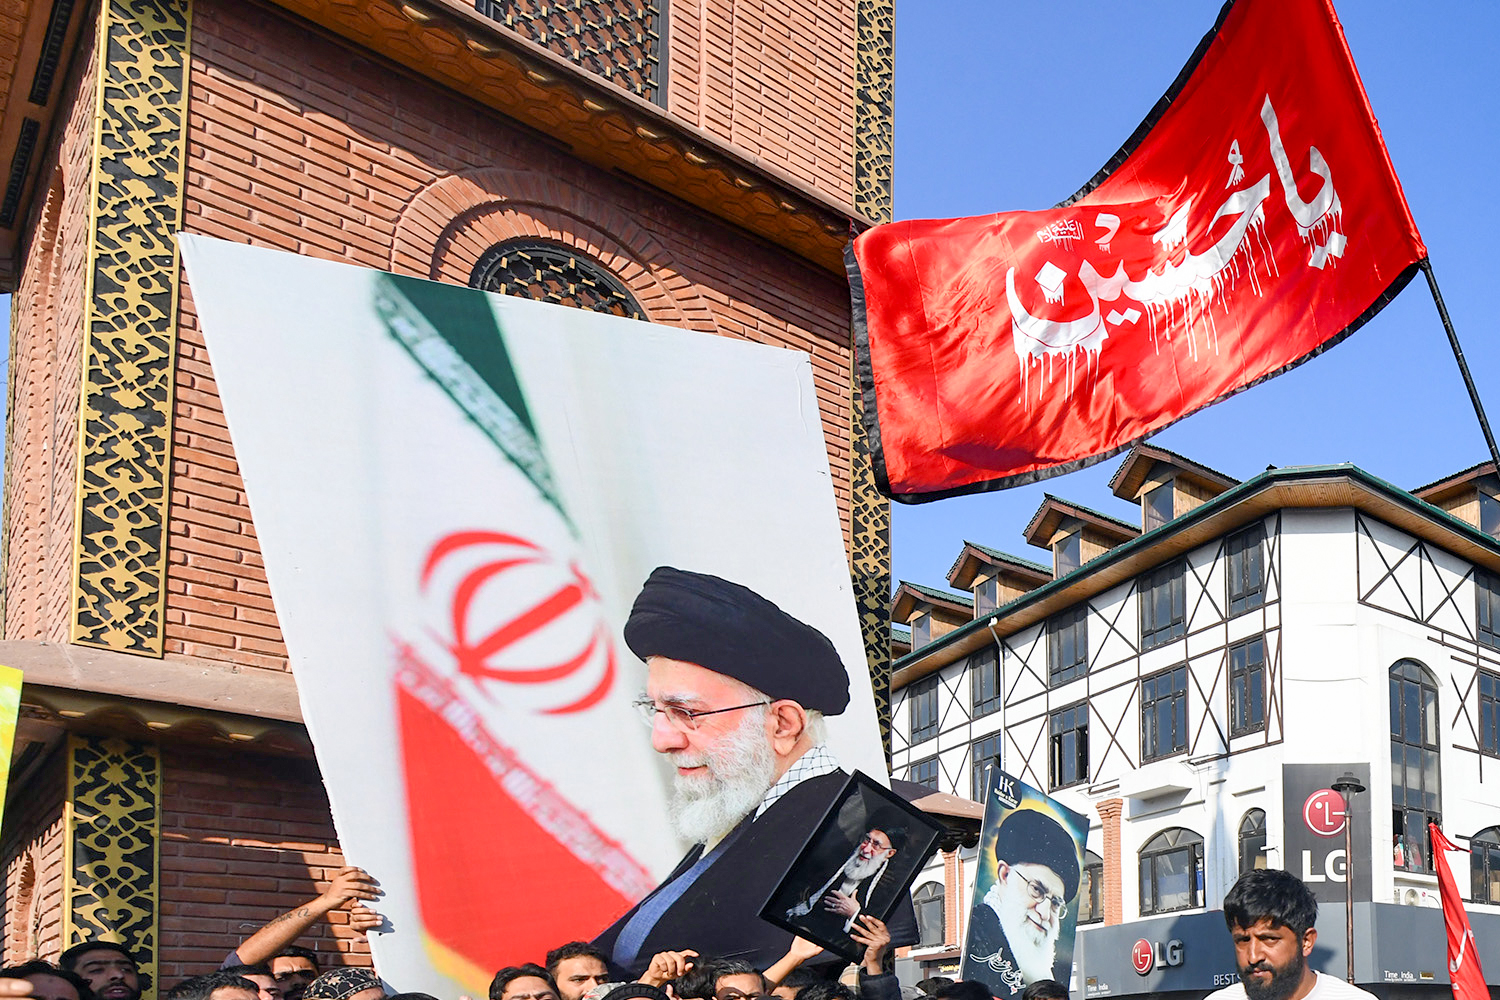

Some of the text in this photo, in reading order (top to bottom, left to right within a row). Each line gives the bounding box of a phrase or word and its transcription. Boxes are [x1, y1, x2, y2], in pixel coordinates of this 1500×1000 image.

[1302, 848, 1354, 883] LG
[1155, 939, 1184, 969] LG
[1213, 973, 1235, 986] BEST
